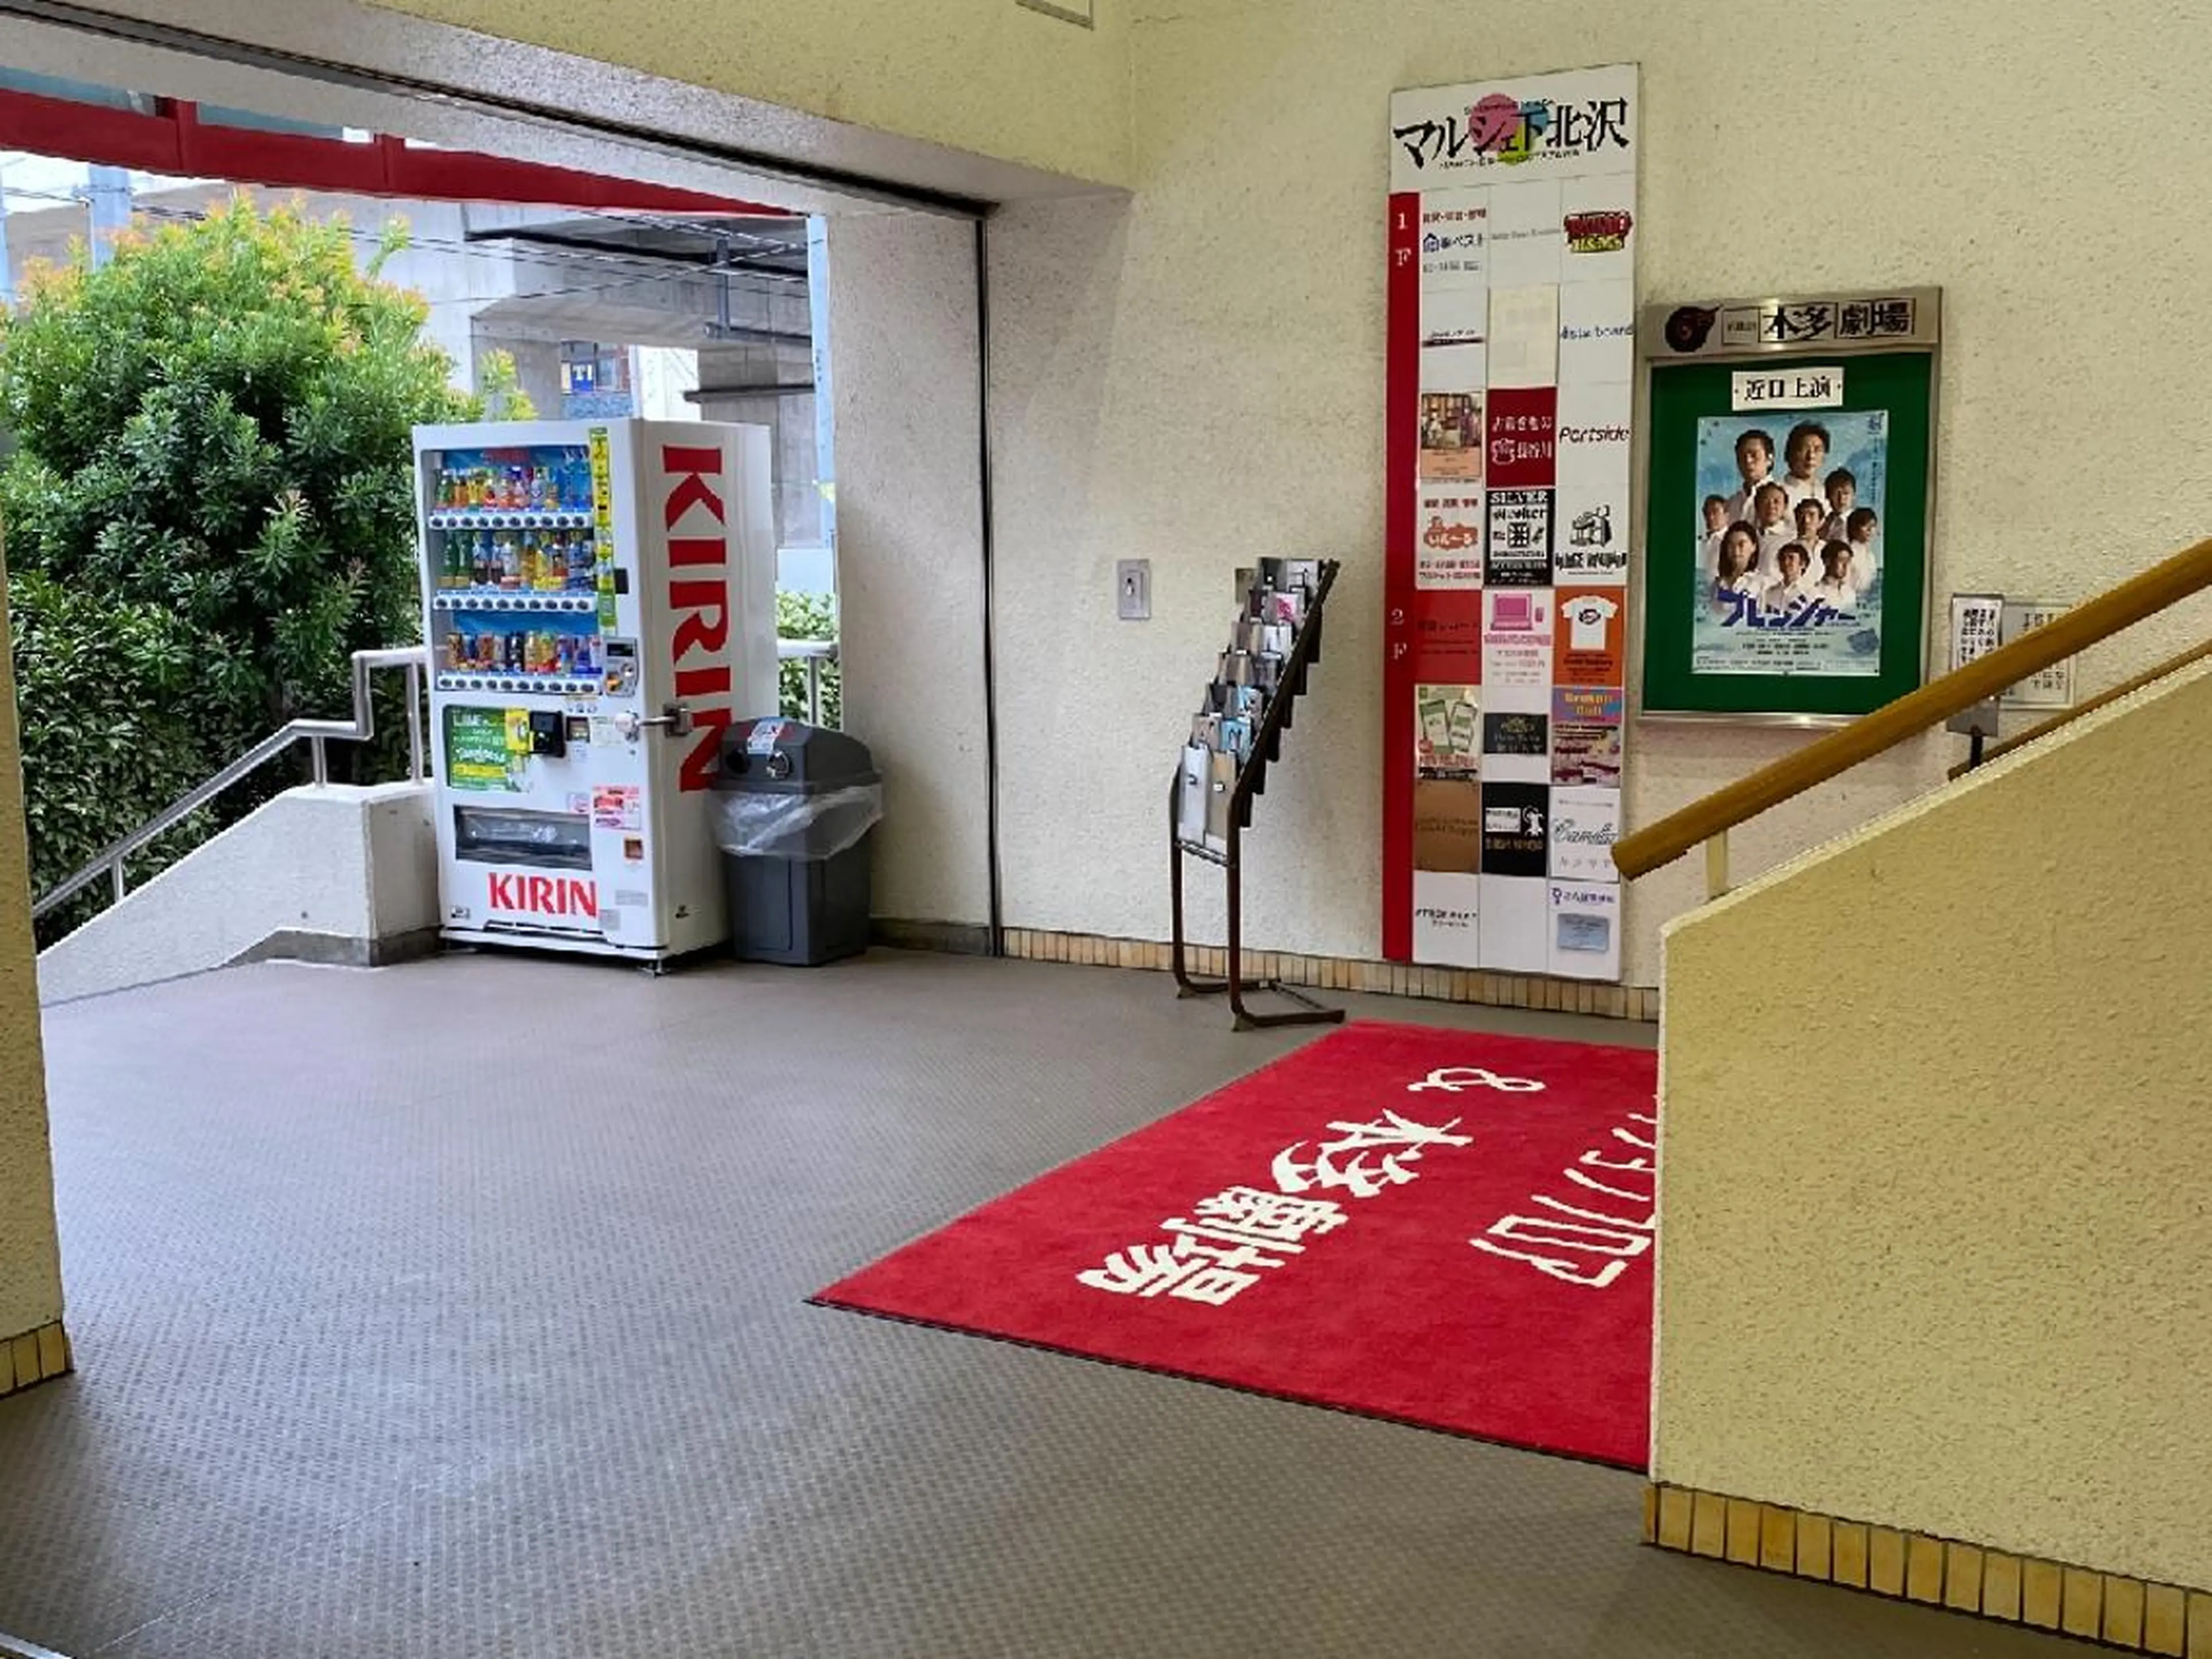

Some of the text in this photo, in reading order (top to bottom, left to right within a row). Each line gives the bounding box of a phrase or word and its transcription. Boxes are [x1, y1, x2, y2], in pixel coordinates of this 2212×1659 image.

[1393, 97, 1629, 169] マルシェ下北沢
[1762, 301, 1911, 340] 本多劇場
[1559, 425, 1631, 444] Portside
[1490, 491, 1548, 503] SILVER
[662, 444, 733, 793] KIRIN
[488, 872, 597, 919] KIRIN
[1077, 1109, 1474, 1305] 本多劇場
